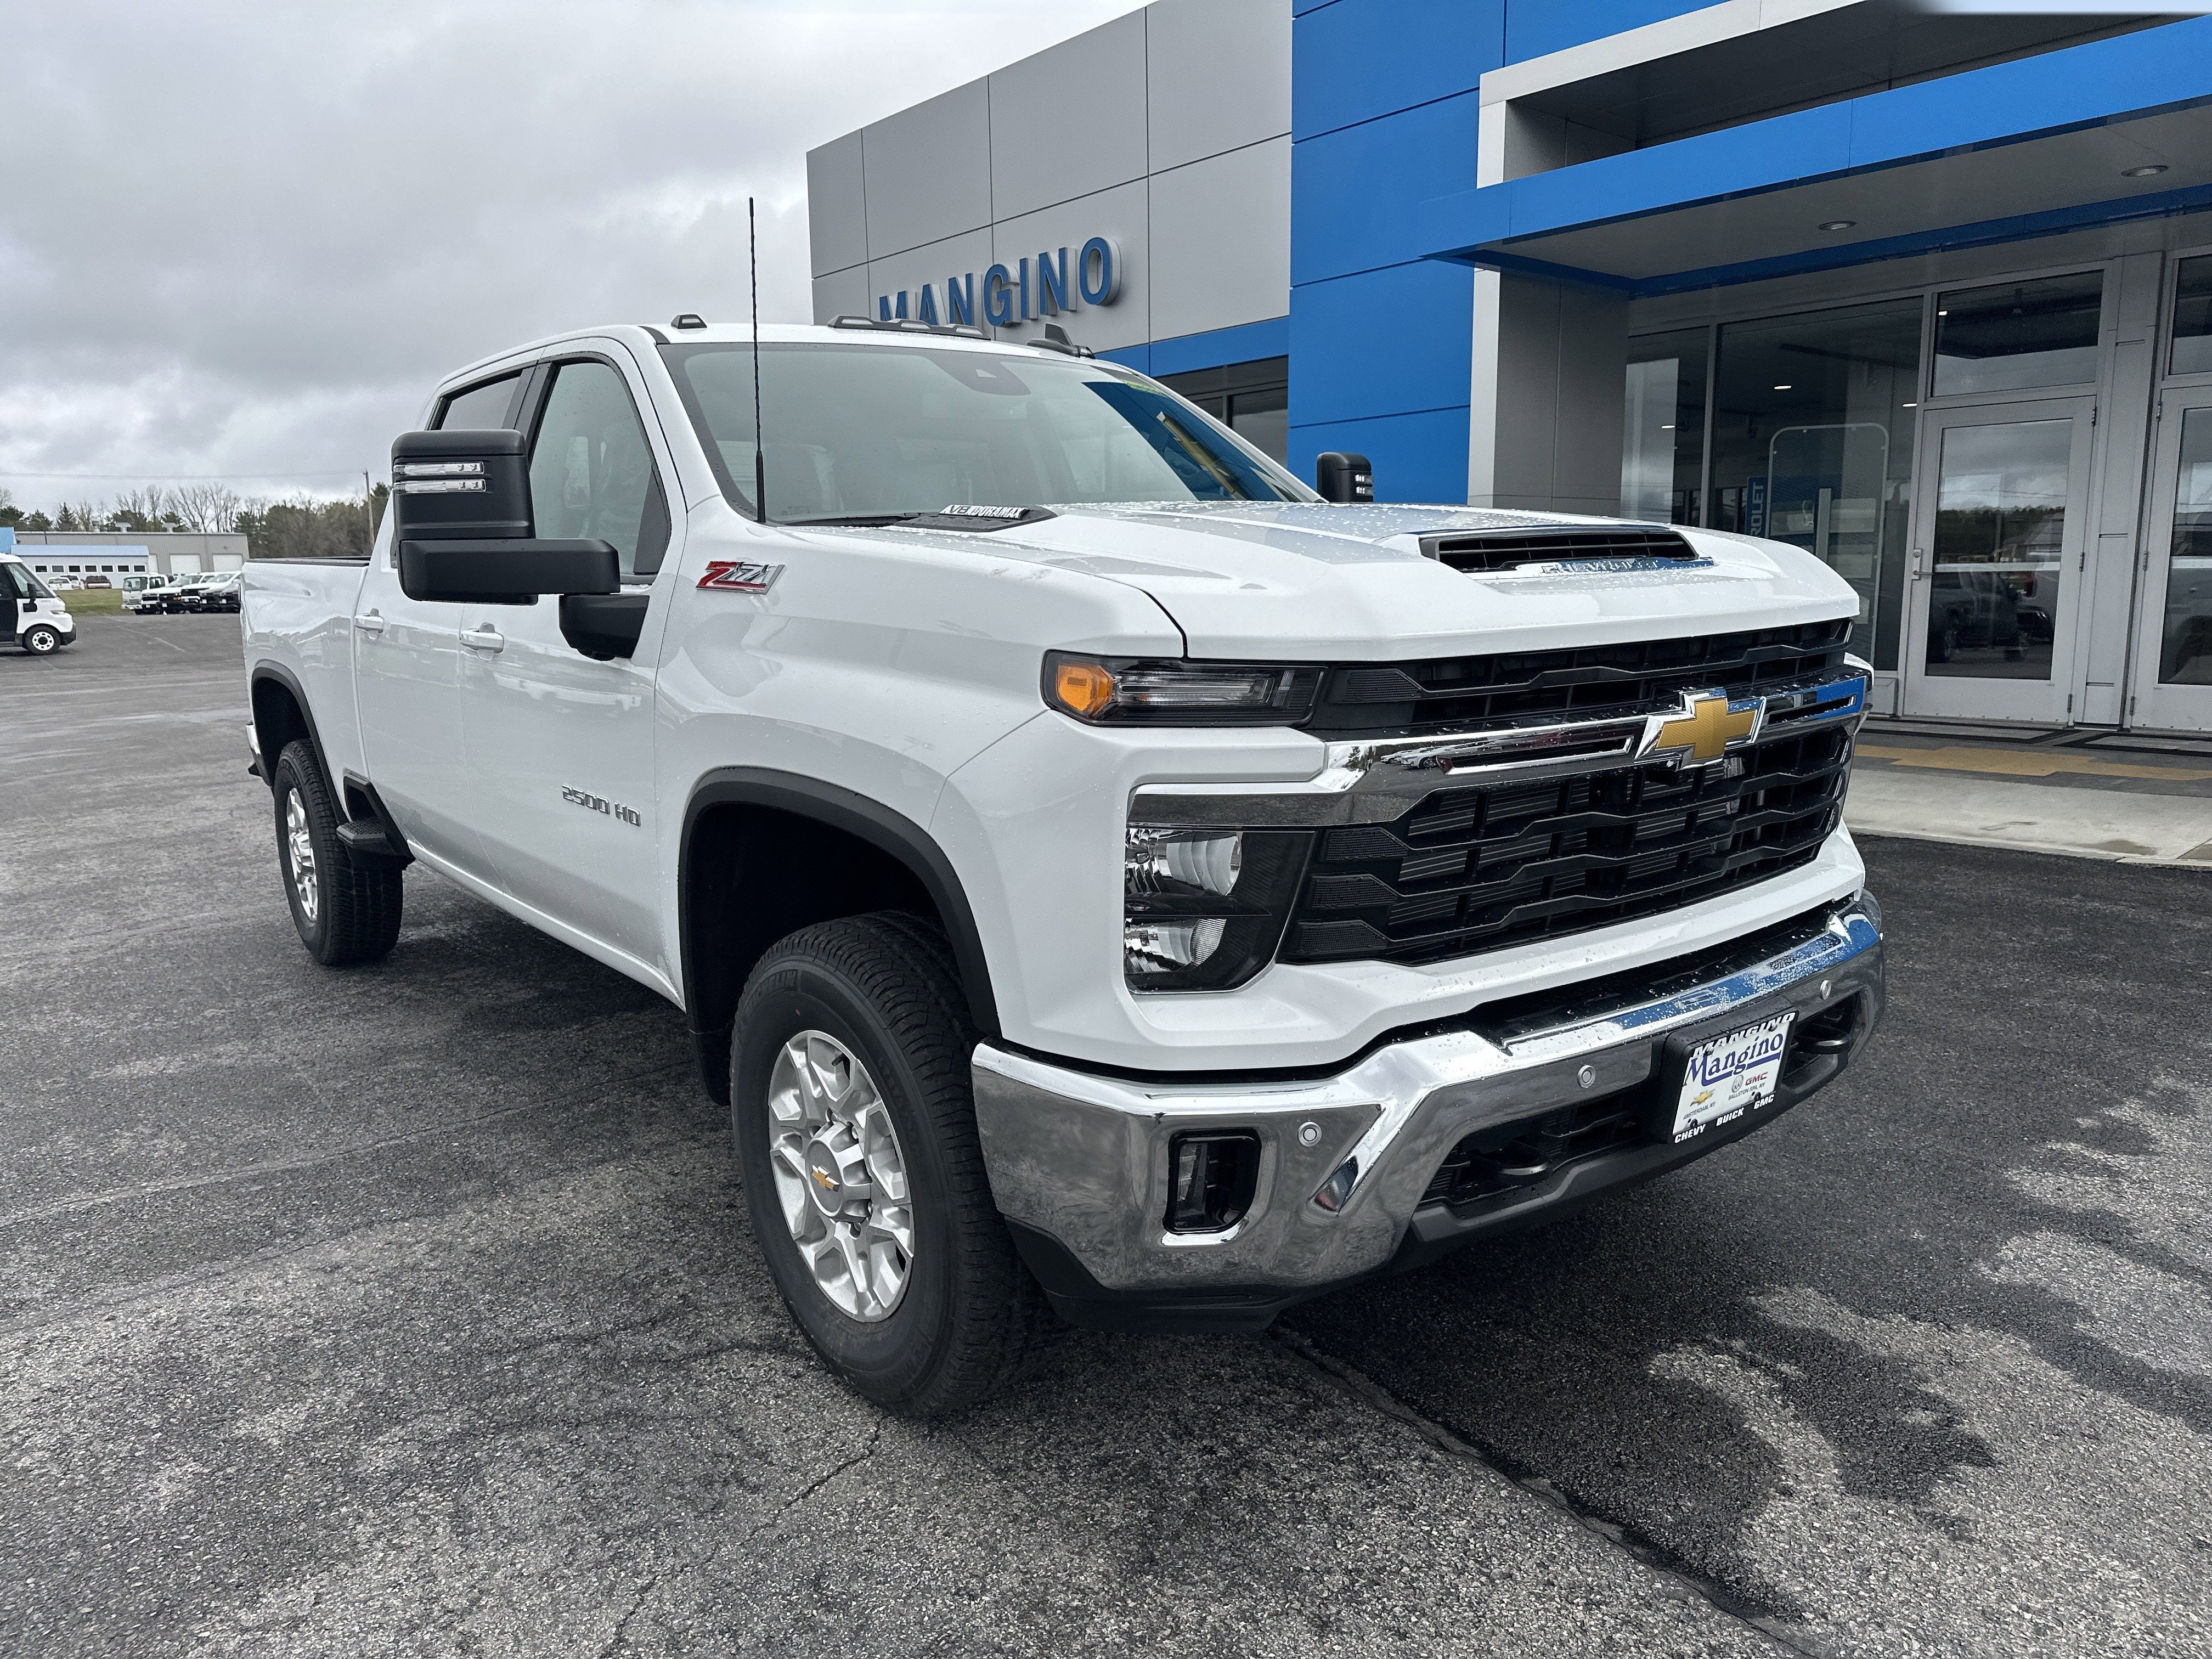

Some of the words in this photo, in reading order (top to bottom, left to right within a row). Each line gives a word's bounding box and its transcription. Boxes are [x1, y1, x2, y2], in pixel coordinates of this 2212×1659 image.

[879, 236, 1121, 328] MANGINO
[969, 505, 1026, 519] DURAMAX
[696, 561, 785, 595] Z71
[562, 785, 611, 815] 2500
[614, 802, 641, 827] HD
[1692, 1012, 1796, 1057] MANGINO
[1682, 1032, 1783, 1087] Mangino
[1745, 1071, 1768, 1086] GMC
[1674, 1124, 1706, 1143] CHEVY
[1716, 1108, 1745, 1126] BUICK
[1753, 1094, 1775, 1110] GMC
